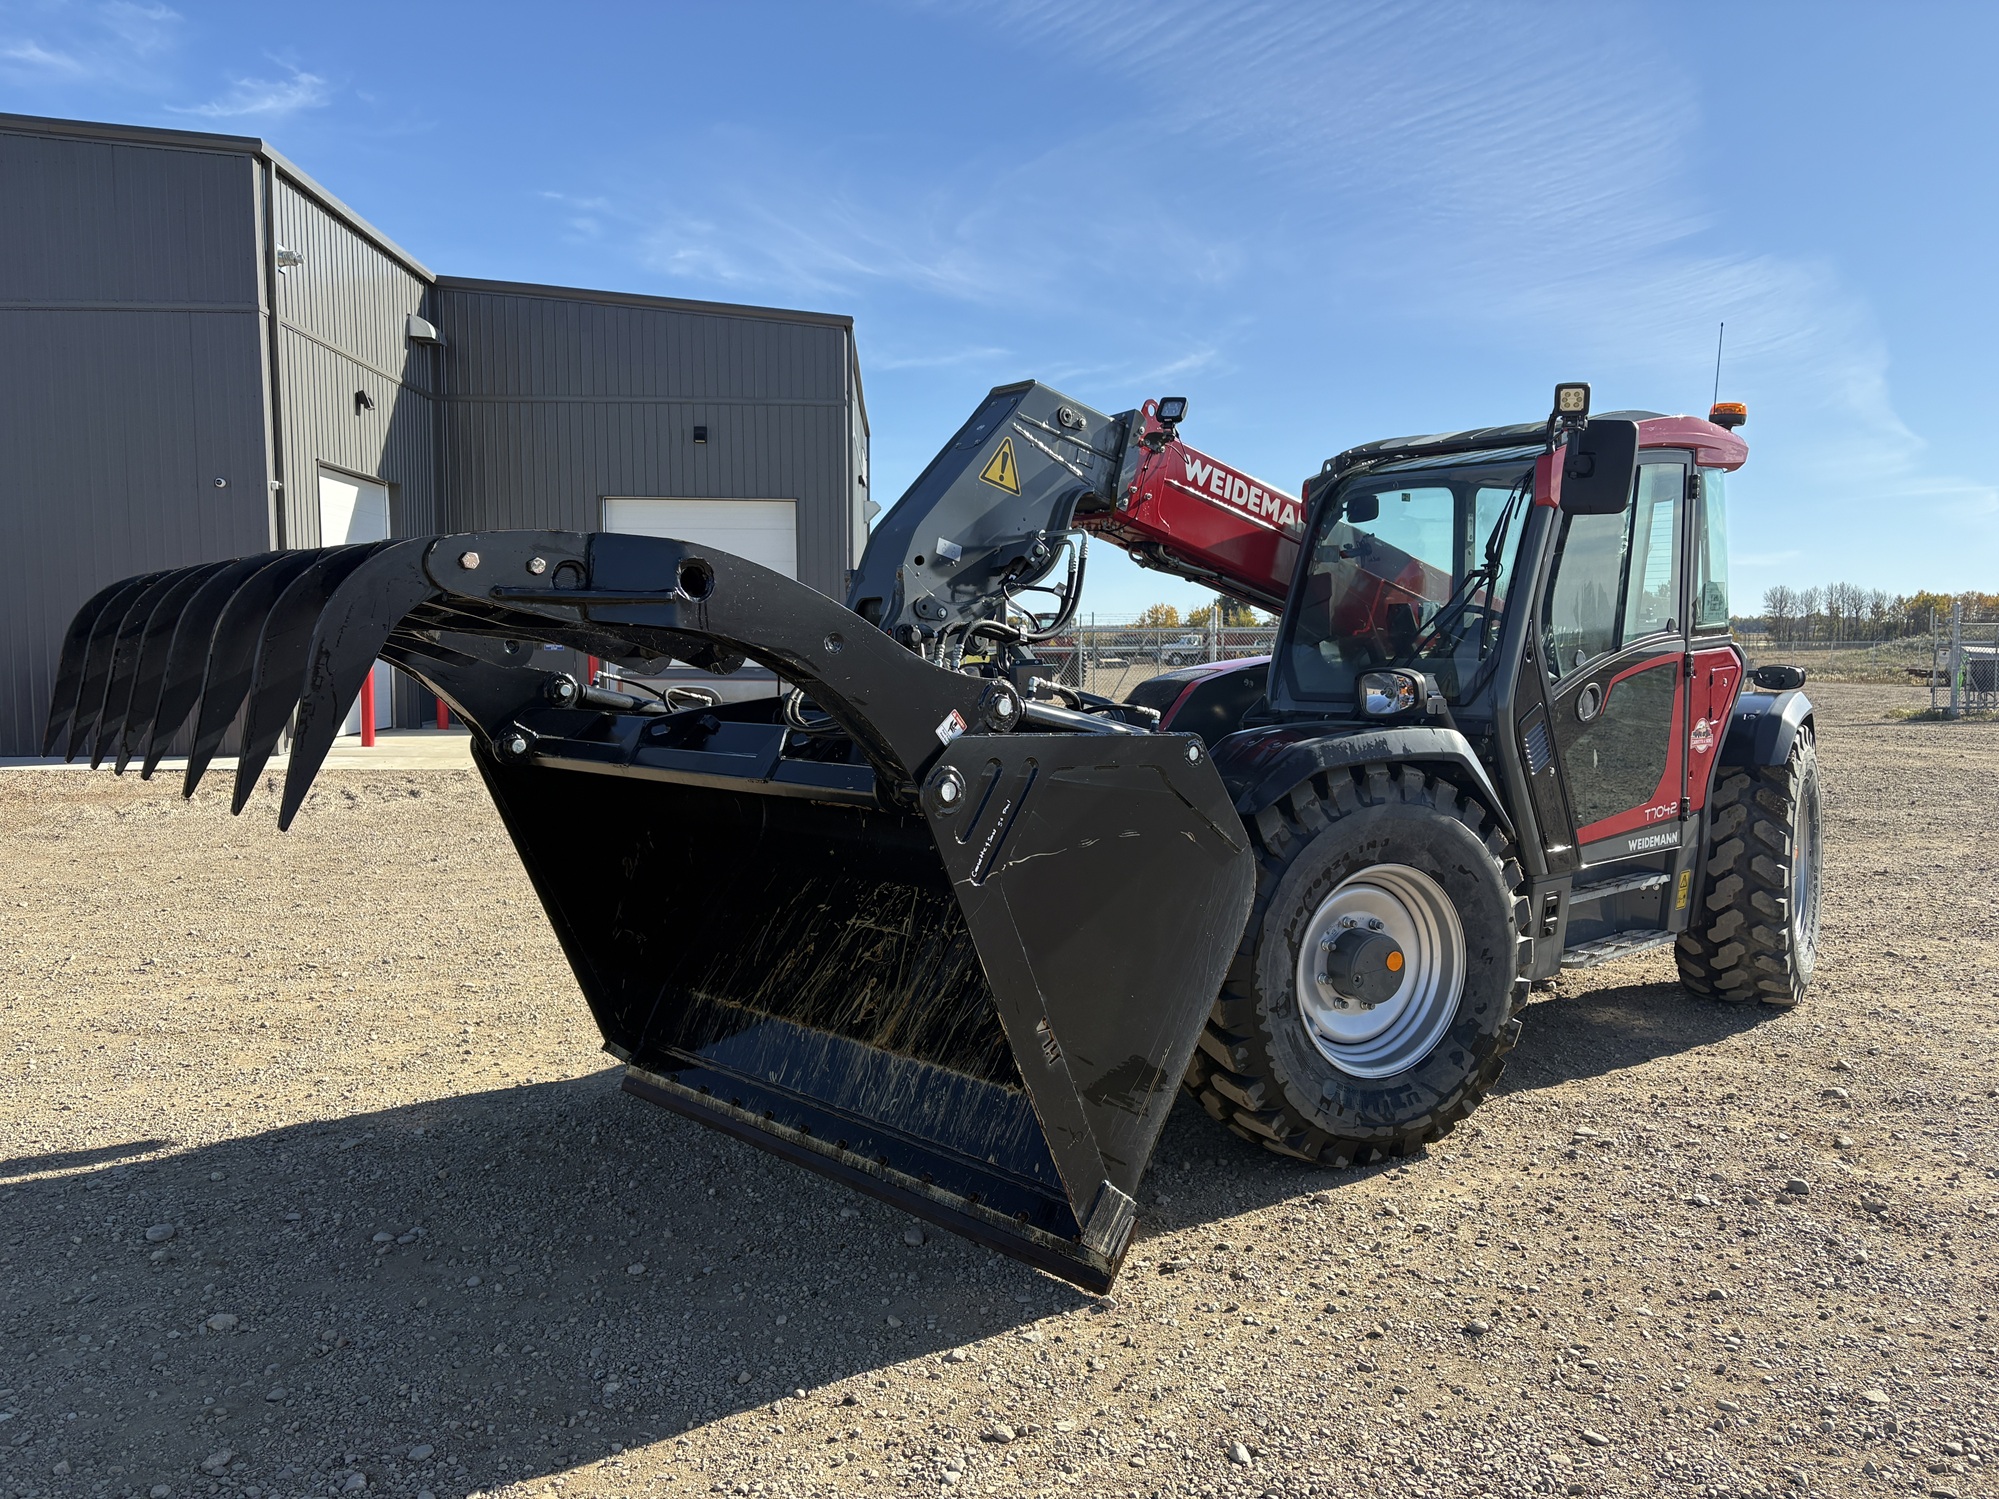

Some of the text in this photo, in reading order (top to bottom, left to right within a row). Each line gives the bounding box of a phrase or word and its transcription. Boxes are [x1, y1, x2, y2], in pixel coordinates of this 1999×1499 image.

[1184, 454, 1305, 535] WEIDEMA
[1644, 801, 1678, 821] T7042
[1628, 831, 1678, 852] WEIDEMANN
